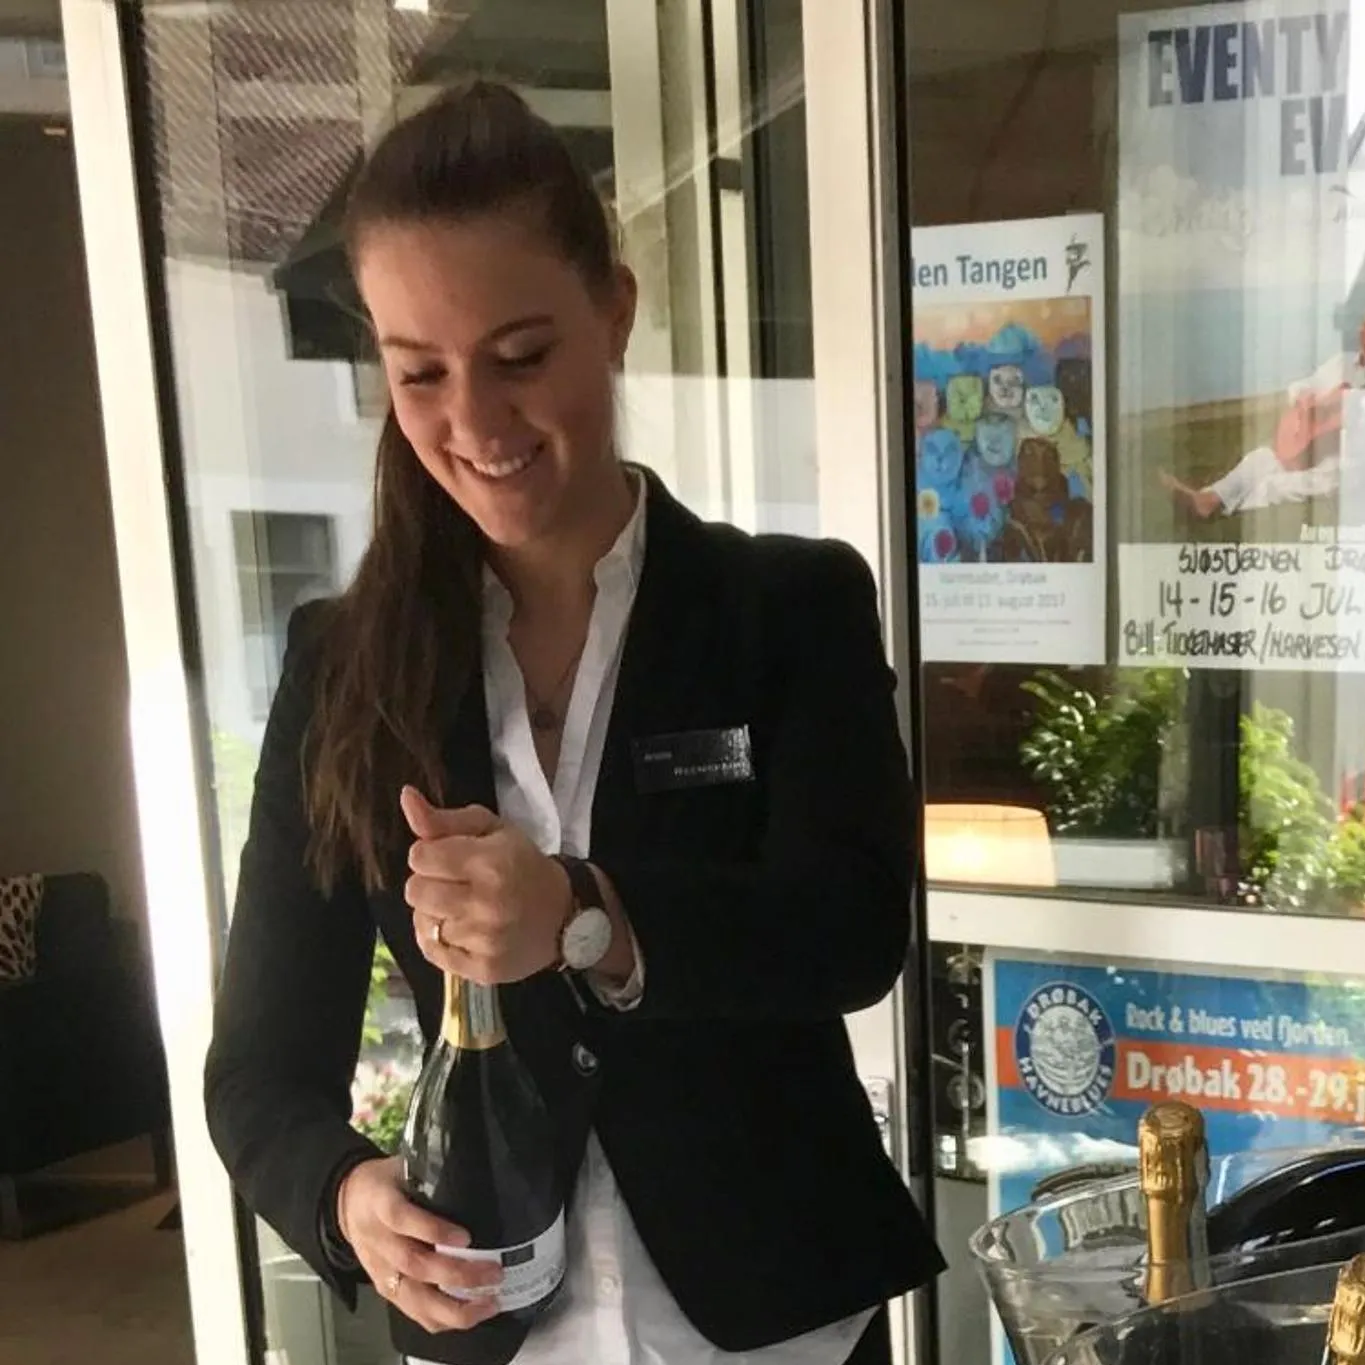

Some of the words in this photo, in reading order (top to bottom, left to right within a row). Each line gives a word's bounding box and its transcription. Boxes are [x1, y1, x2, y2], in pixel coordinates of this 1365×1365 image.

[956, 254, 1048, 290] Tangen
[1125, 1002, 1165, 1032] Rock
[1169, 1006, 1184, 1034] &
[1188, 1008, 1237, 1038] blues
[1240, 1014, 1273, 1042] ved
[1126, 1050, 1241, 1100] Drøbak
